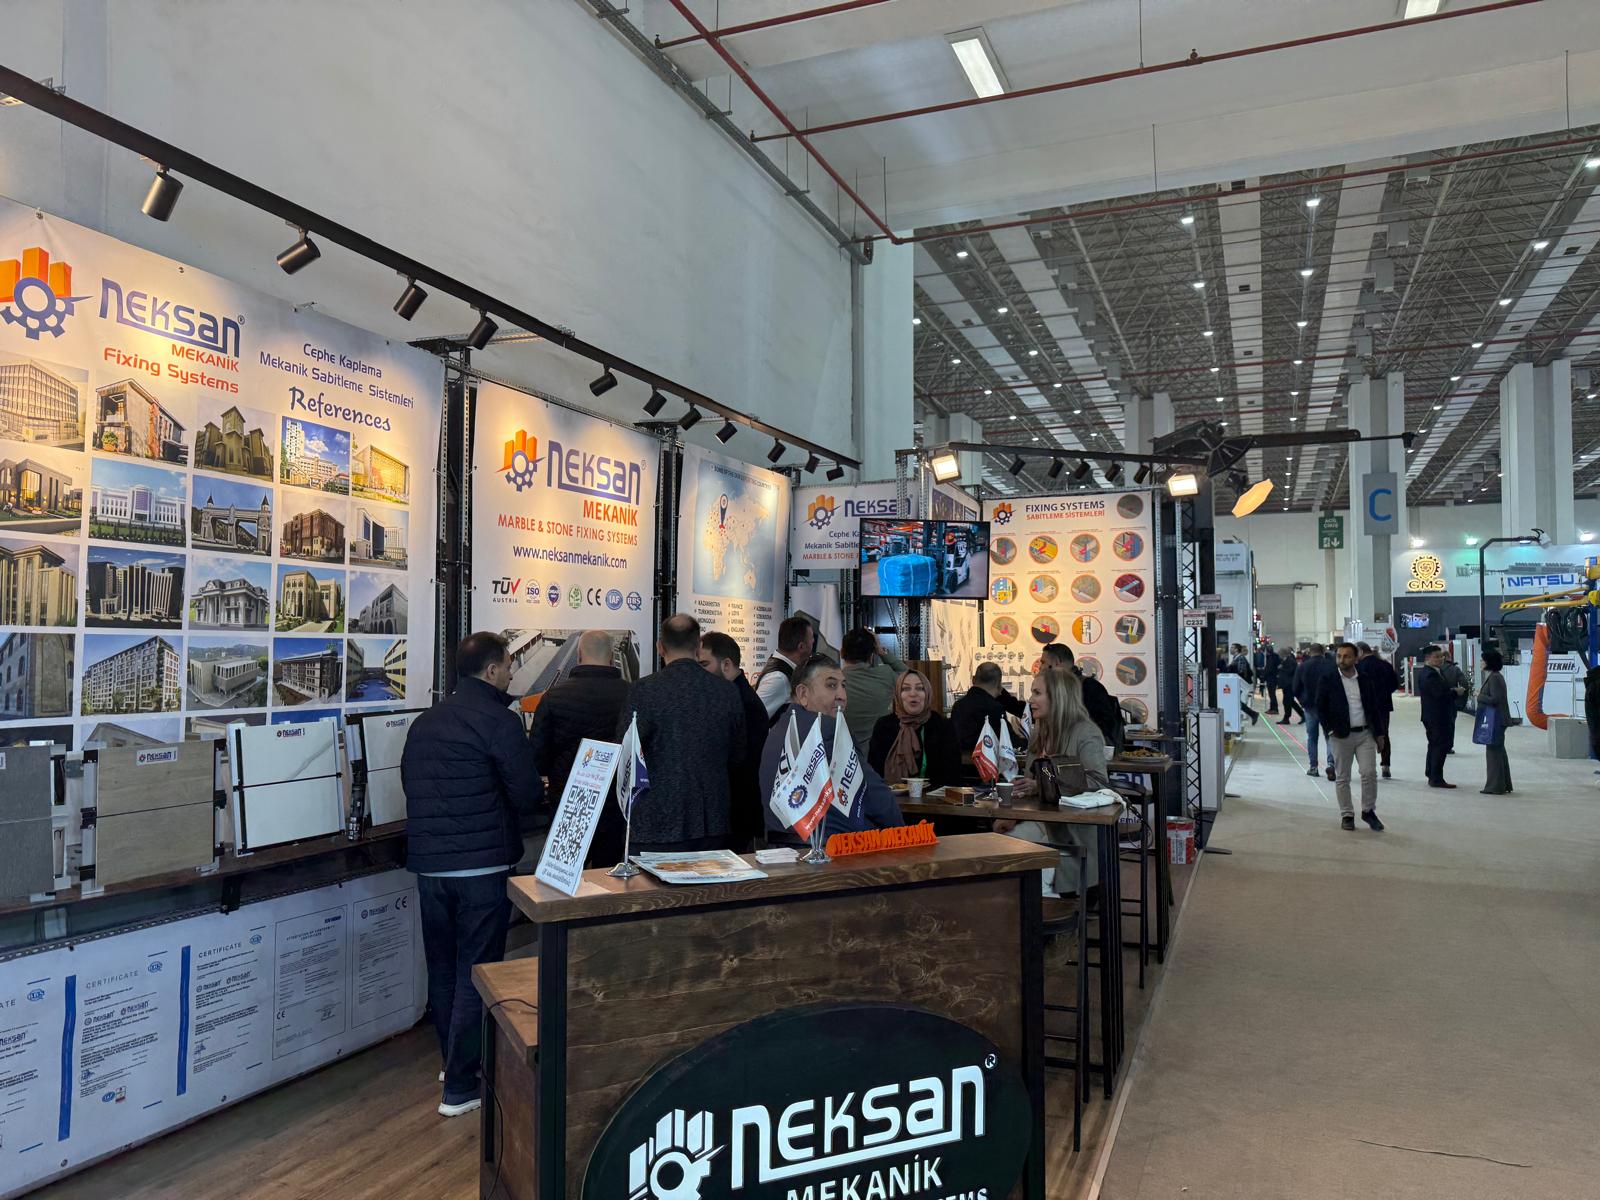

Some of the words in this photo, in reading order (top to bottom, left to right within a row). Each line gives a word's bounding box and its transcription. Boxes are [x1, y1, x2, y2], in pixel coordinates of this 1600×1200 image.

[171, 343, 239, 373] MEKANİK
[303, 343, 336, 364] Cephe
[339, 353, 382, 378] Kaplama
[104, 347, 161, 377] Fixing
[167, 363, 239, 394] Systems
[260, 351, 308, 377] Mekanik
[312, 367, 363, 393] Sabitleme
[369, 384, 414, 409] Sistemleri
[288, 386, 391, 431] References
[583, 500, 638, 527] MEKANİK
[1026, 503, 1058, 513] FIXING
[1060, 500, 1105, 511] SYSTEMS
[1369, 488, 1392, 522] C
[1026, 511, 1064, 520] SABİTLEME
[498, 514, 535, 531] MARBLE
[537, 521, 544, 532] &
[546, 521, 573, 537] STONE
[576, 526, 604, 541] FIXING
[607, 530, 638, 546] SYSTEMS
[829, 530, 850, 541] Cephe
[803, 552, 827, 560] MARBLE
[834, 551, 854, 559] STONE
[804, 541, 833, 550] Mekanik
[513, 545, 627, 569] www.neksanmekanik.com
[1408, 579, 1445, 590] GMS
[1507, 574, 1575, 587] NATSU
[527, 587, 540, 596] ISO
[198, 943, 242, 958] CERTIFICATE
[86, 969, 139, 989] CERTIFICATE
